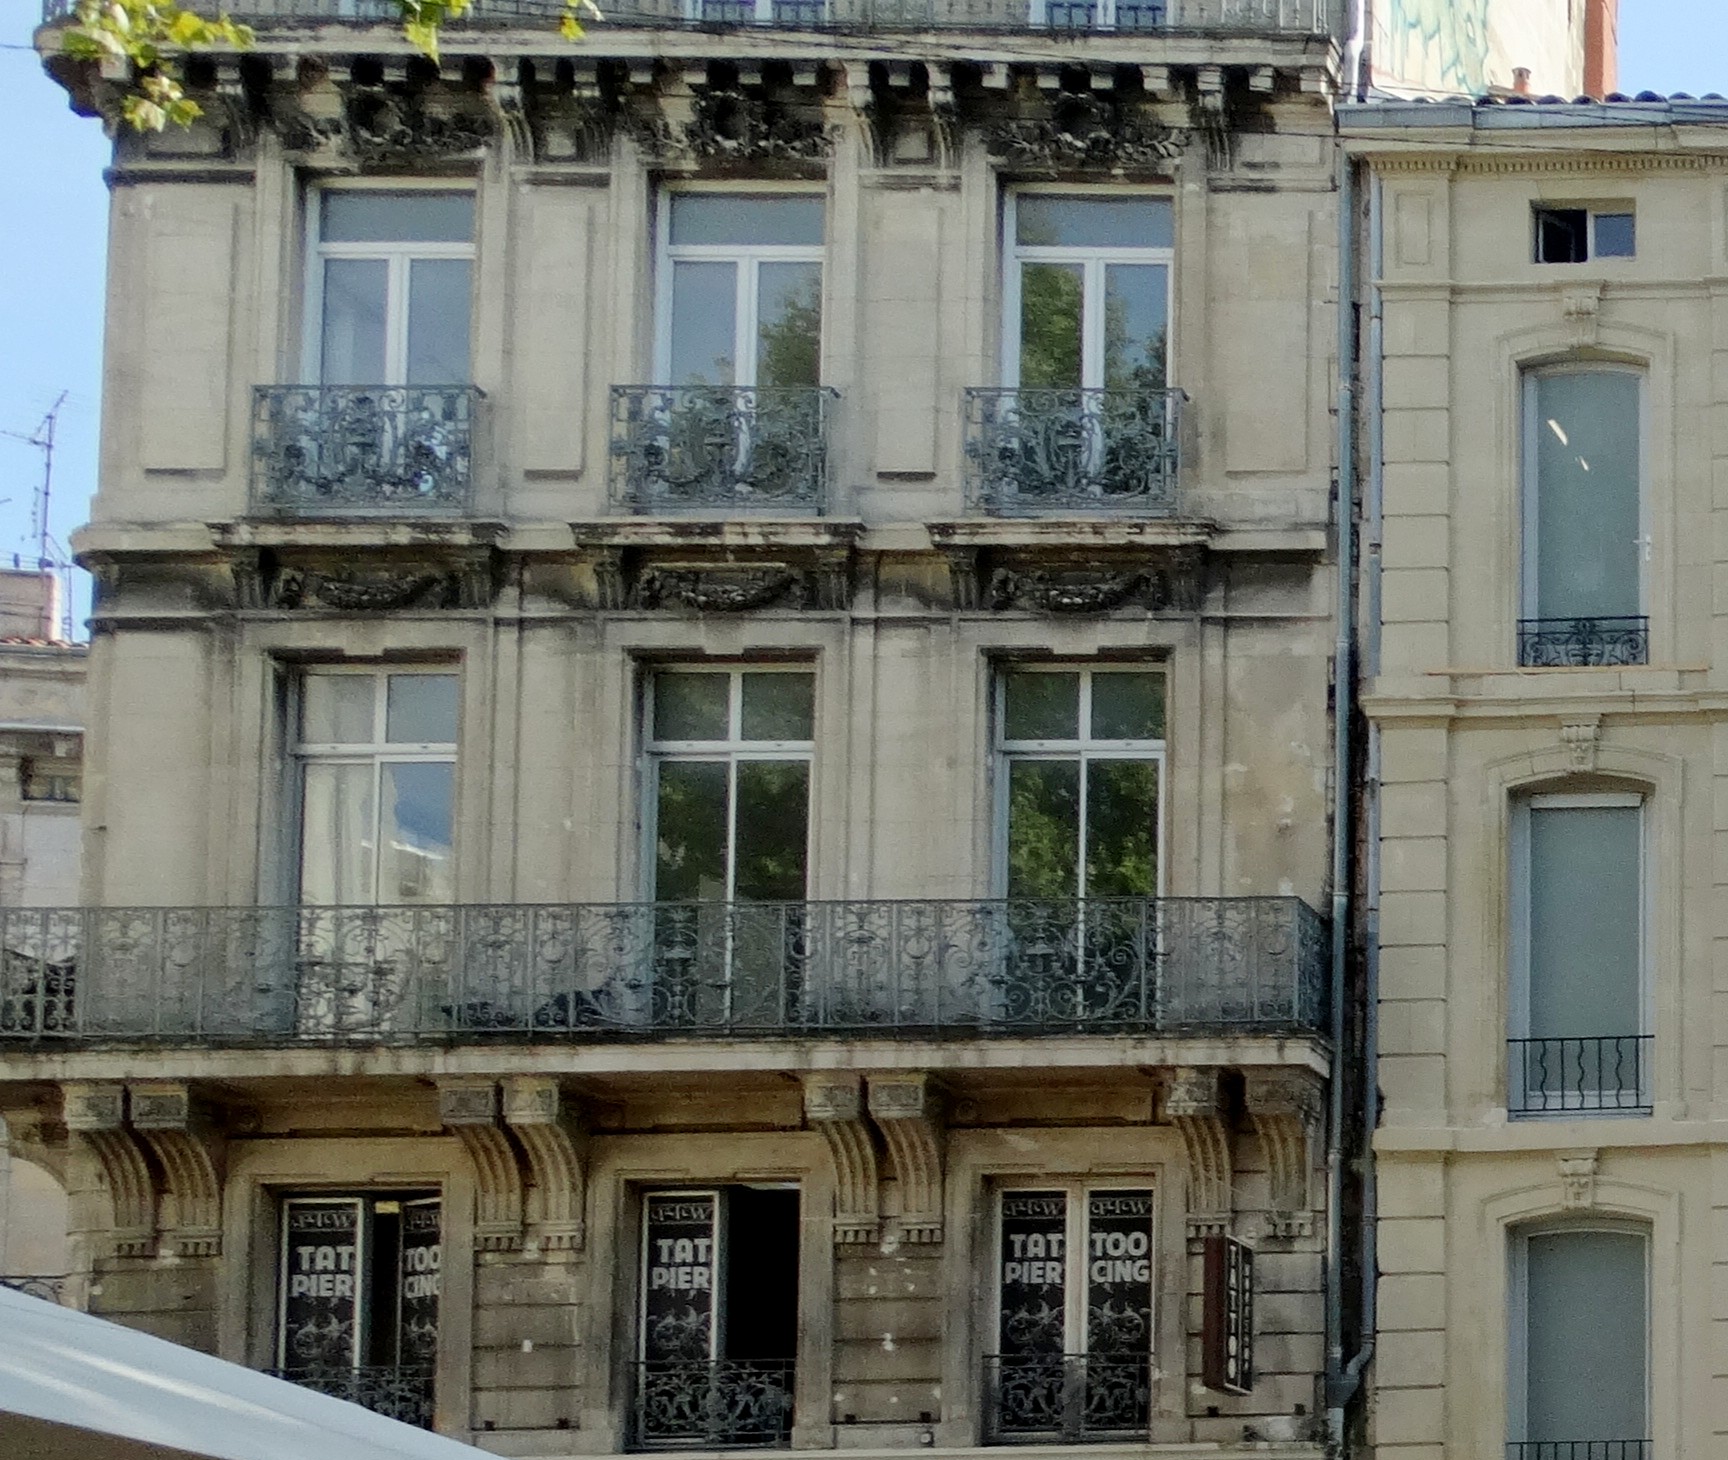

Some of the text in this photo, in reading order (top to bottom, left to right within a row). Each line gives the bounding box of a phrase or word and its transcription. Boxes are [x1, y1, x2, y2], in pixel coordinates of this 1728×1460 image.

[657, 1238, 712, 1263] TAT
[1009, 1233, 1064, 1259] TAT
[1091, 1231, 1149, 1257] TOO
[297, 1245, 355, 1271] TAT
[405, 1245, 441, 1272] TOO
[652, 1266, 711, 1290] PIER
[1005, 1261, 1063, 1285] PIER
[1091, 1259, 1150, 1284] CING
[292, 1274, 353, 1298] PIER
